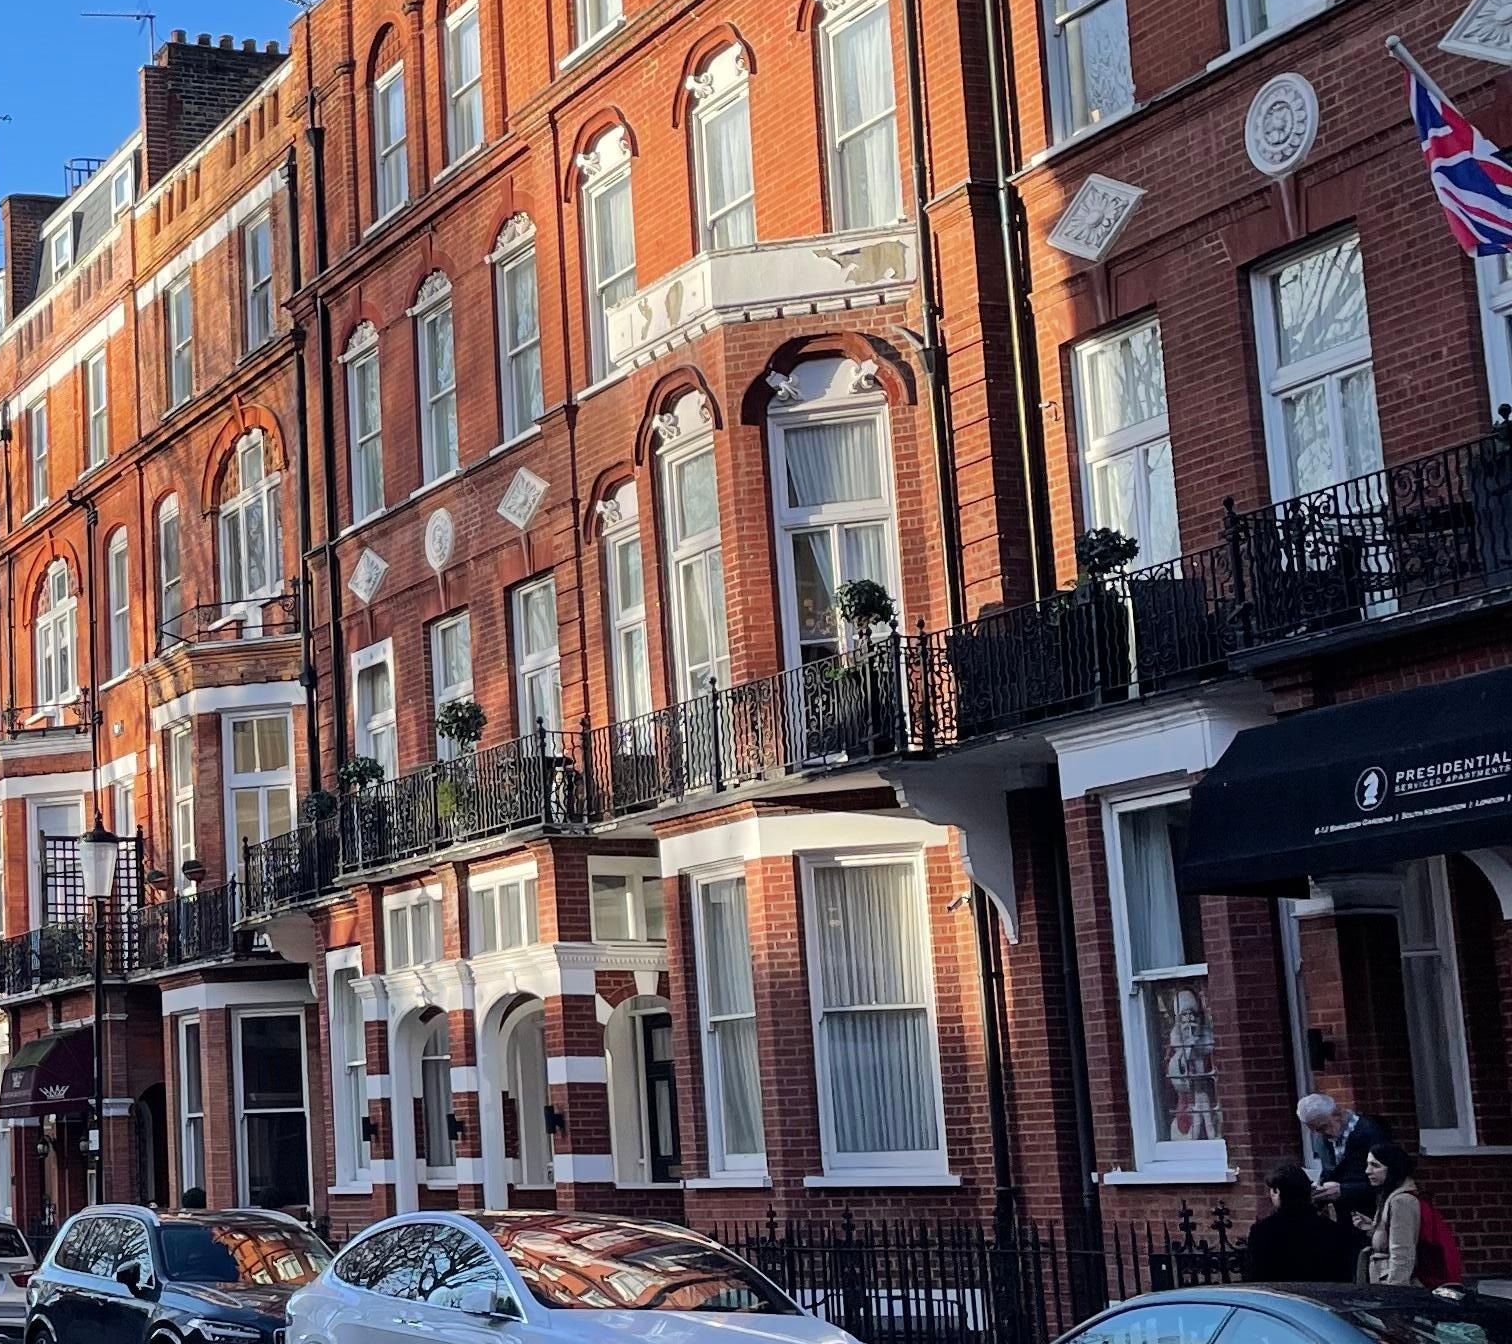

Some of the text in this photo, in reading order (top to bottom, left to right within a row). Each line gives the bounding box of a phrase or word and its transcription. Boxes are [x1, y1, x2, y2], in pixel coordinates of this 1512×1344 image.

[1394, 764, 1512, 793] SERVICED APARTMENTS
[1395, 751, 1512, 783] PRESIDENTIAL
